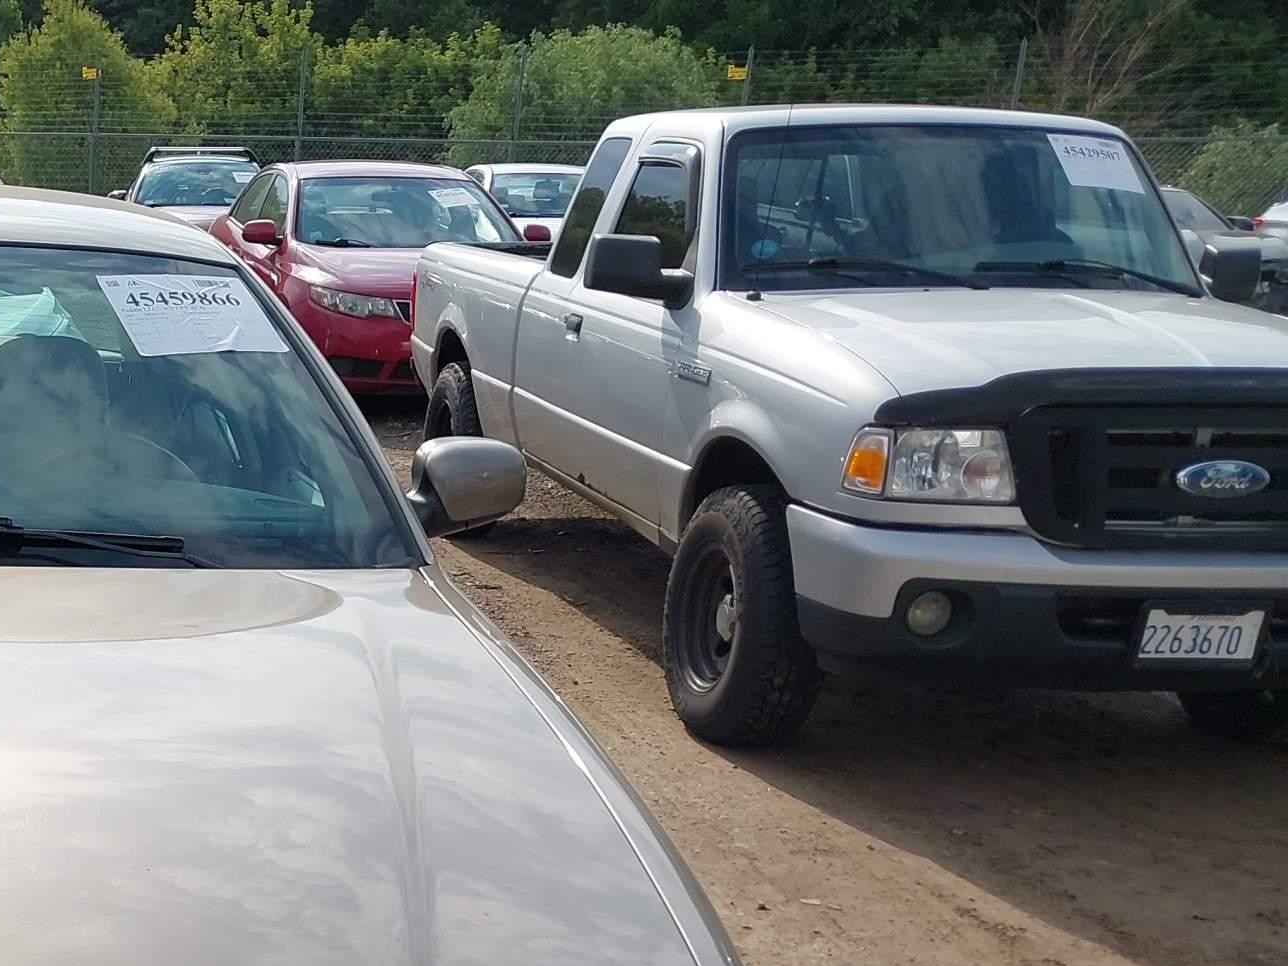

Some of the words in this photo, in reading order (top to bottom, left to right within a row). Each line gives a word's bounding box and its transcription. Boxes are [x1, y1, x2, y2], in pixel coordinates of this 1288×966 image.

[1062, 145, 1121, 161] 45429507
[125, 291, 241, 307] 45459866
[1201, 466, 1252, 489] Ford
[1140, 624, 1243, 656] 2263670
